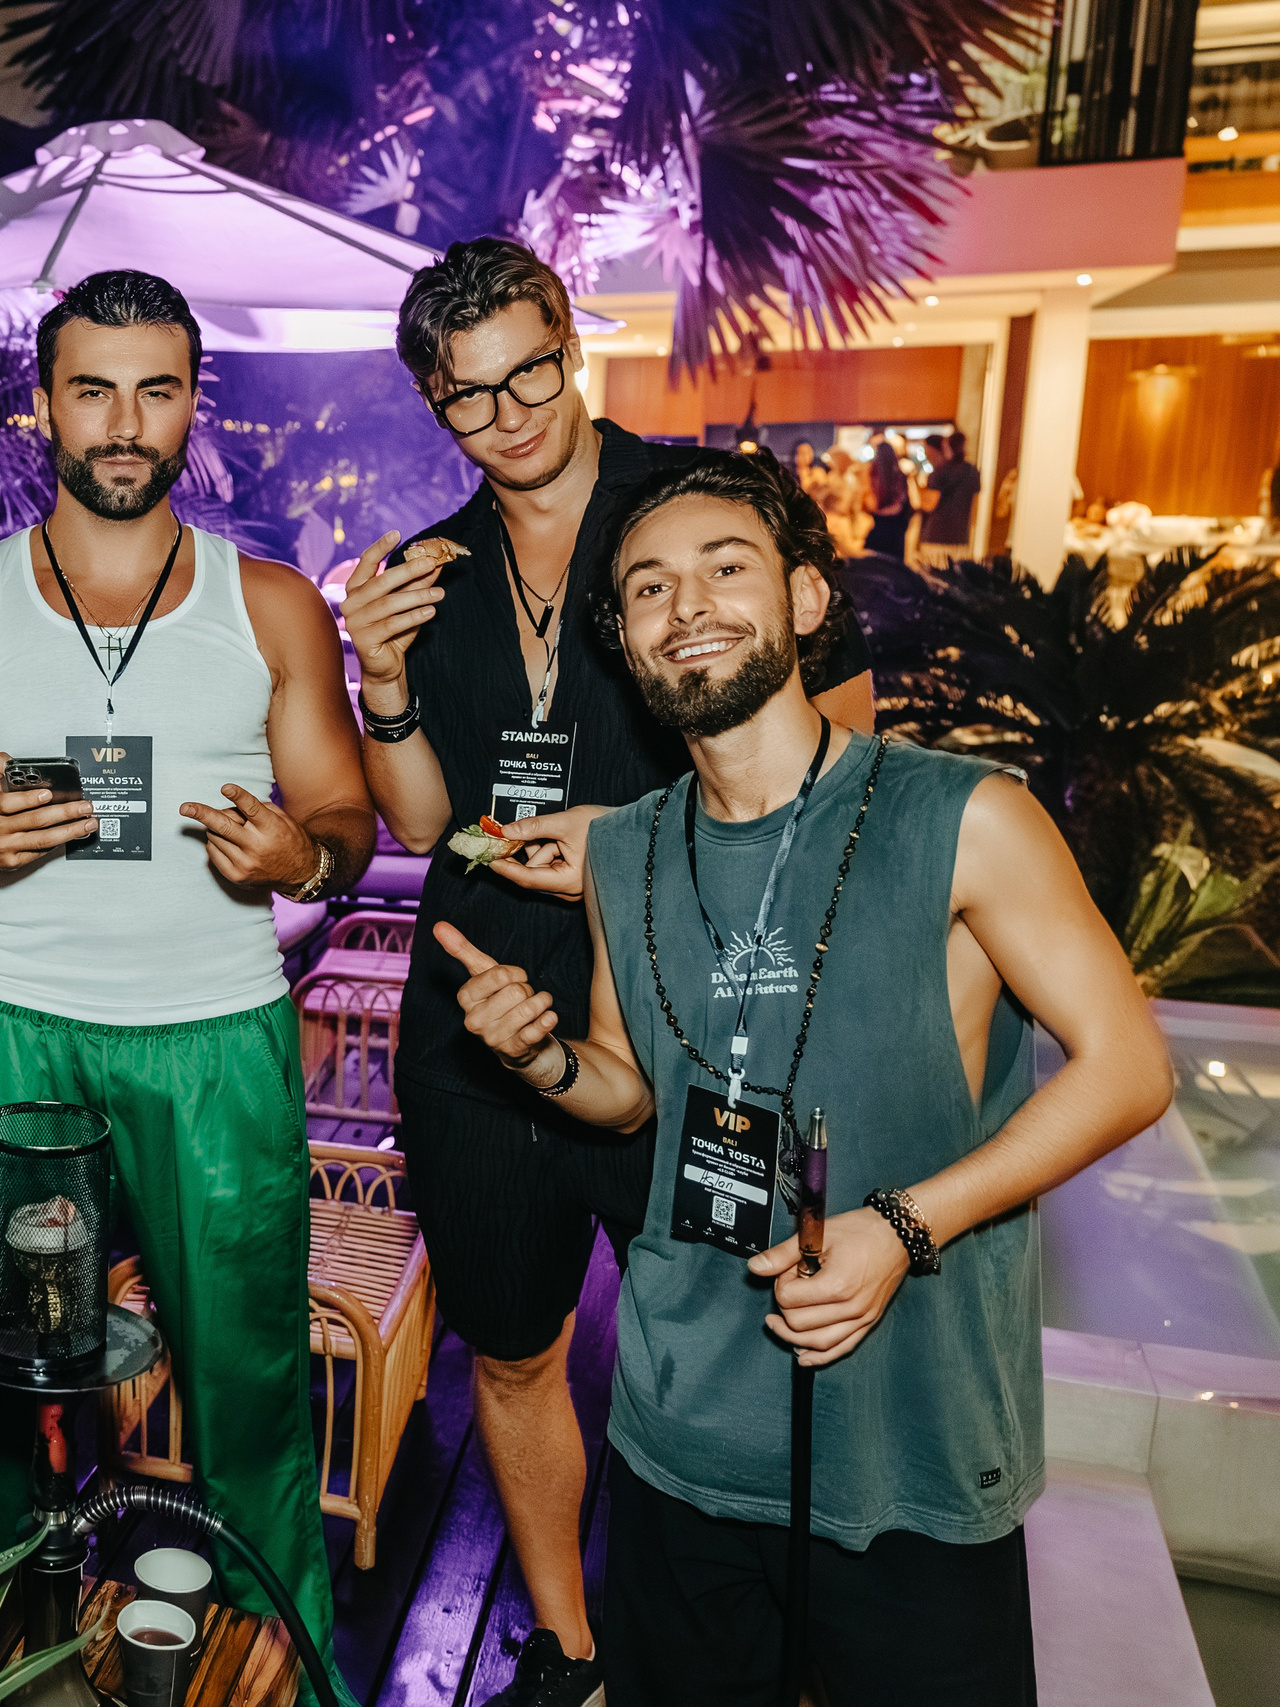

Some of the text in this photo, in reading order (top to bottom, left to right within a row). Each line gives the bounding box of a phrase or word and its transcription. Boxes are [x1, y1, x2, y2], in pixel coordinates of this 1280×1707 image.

[501, 730, 569, 744] STANDARD
[90, 747, 127, 763] VIP
[499, 759, 563, 772] ТОЧКА ROSTA
[80, 777, 144, 785] ОЧКА ROSTA
[506, 785, 552, 799] Сергей
[758, 966, 799, 980] Earth
[755, 983, 798, 995] Future
[713, 1107, 751, 1133] VIP
[722, 1136, 738, 1147] BALI
[691, 1136, 724, 1156] ТОЧКА
[727, 1148, 766, 1170] ROSTA
